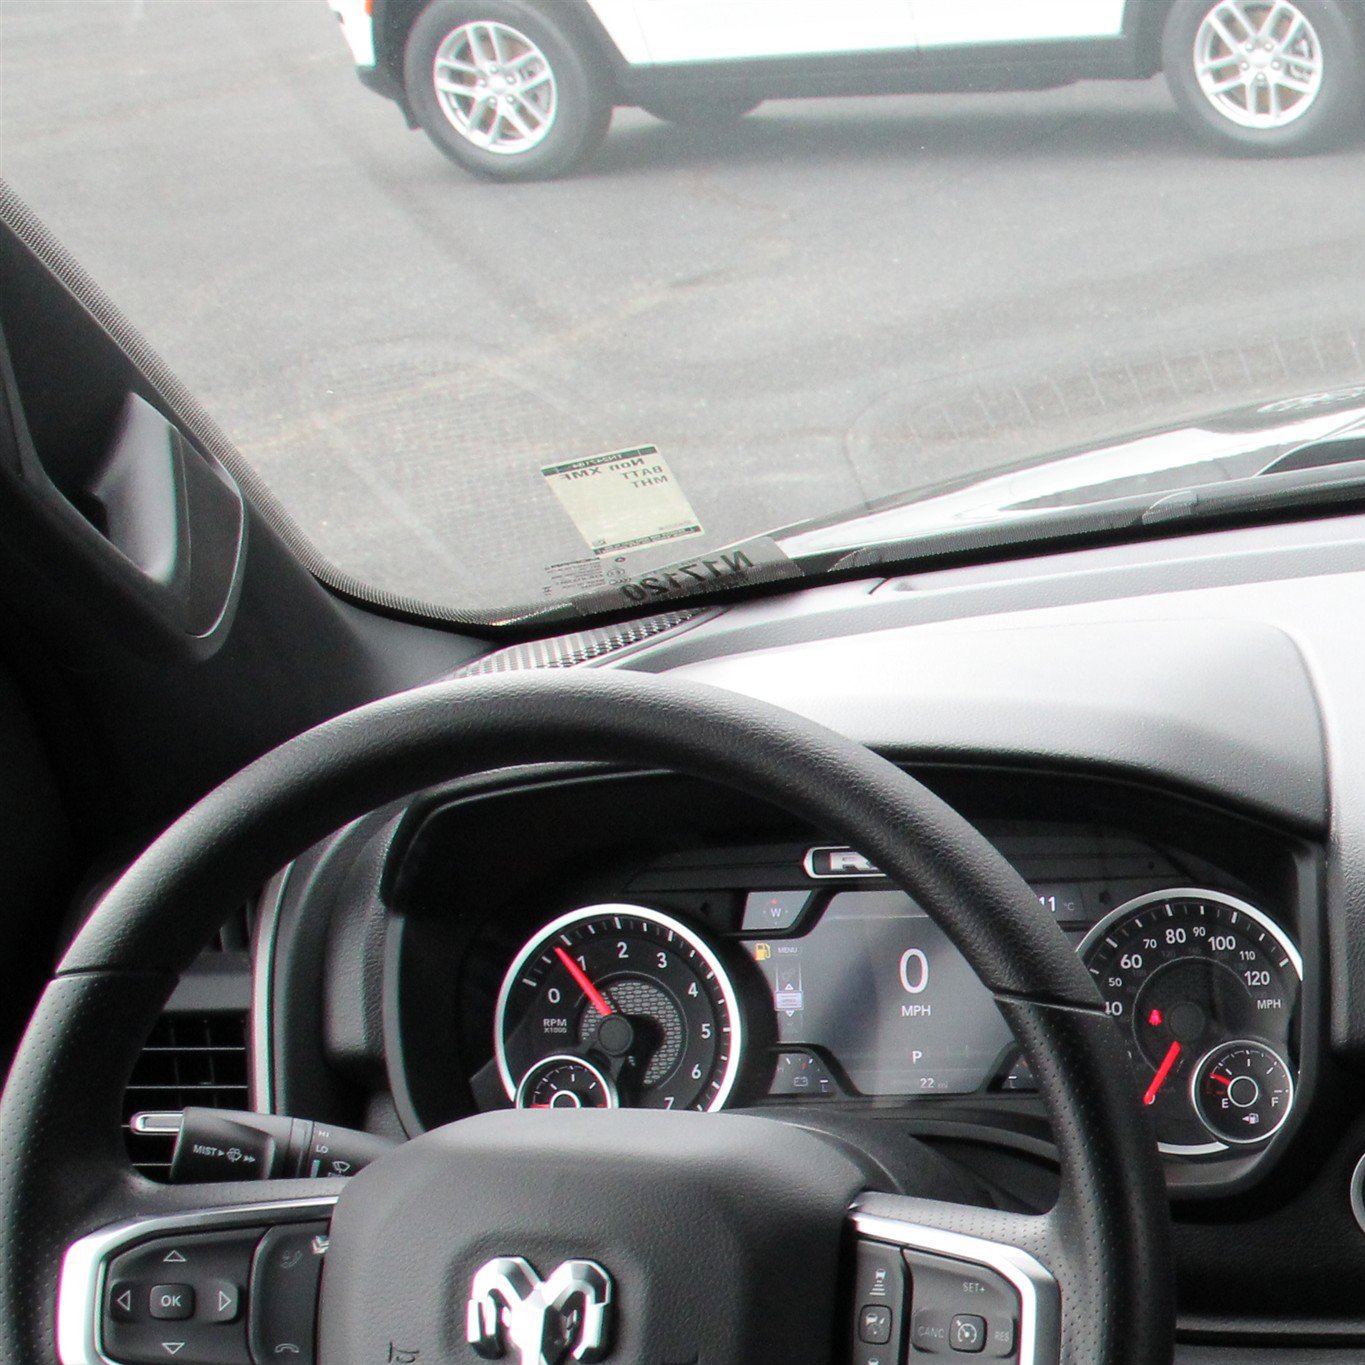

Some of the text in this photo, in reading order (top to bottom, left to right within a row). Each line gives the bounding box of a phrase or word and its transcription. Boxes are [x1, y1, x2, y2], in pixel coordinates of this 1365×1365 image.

[770, 907, 782, 918] W
[1165, 928, 1186, 944] 80
[1193, 926, 1206, 937] 90
[1143, 938, 1157, 949] 70
[1208, 935, 1236, 951] 100
[616, 941, 629, 959] 2
[1239, 950, 1256, 961] 110
[577, 955, 587, 971] 1
[656, 952, 668, 969] 3
[1120, 954, 1143, 969] 60
[899, 947, 930, 994] 0
[1108, 977, 1122, 987] 50
[1244, 971, 1270, 986] 120
[547, 988, 561, 1003] 0
[688, 982, 699, 998] 4
[901, 1004, 931, 1017] MPH
[1257, 1000, 1281, 1010] MPH
[543, 1018, 567, 1027] RPM
[701, 1023, 711, 1039] 5
[912, 1050, 923, 1064] P
[691, 1063, 702, 1080] 6
[920, 1078, 934, 1088] 22
[1222, 1098, 1229, 1108] E
[1271, 1097, 1279, 1107] F
[193, 1144, 217, 1157] MIST
[316, 1145, 329, 1154] LO
[160, 1295, 182, 1307] OK
